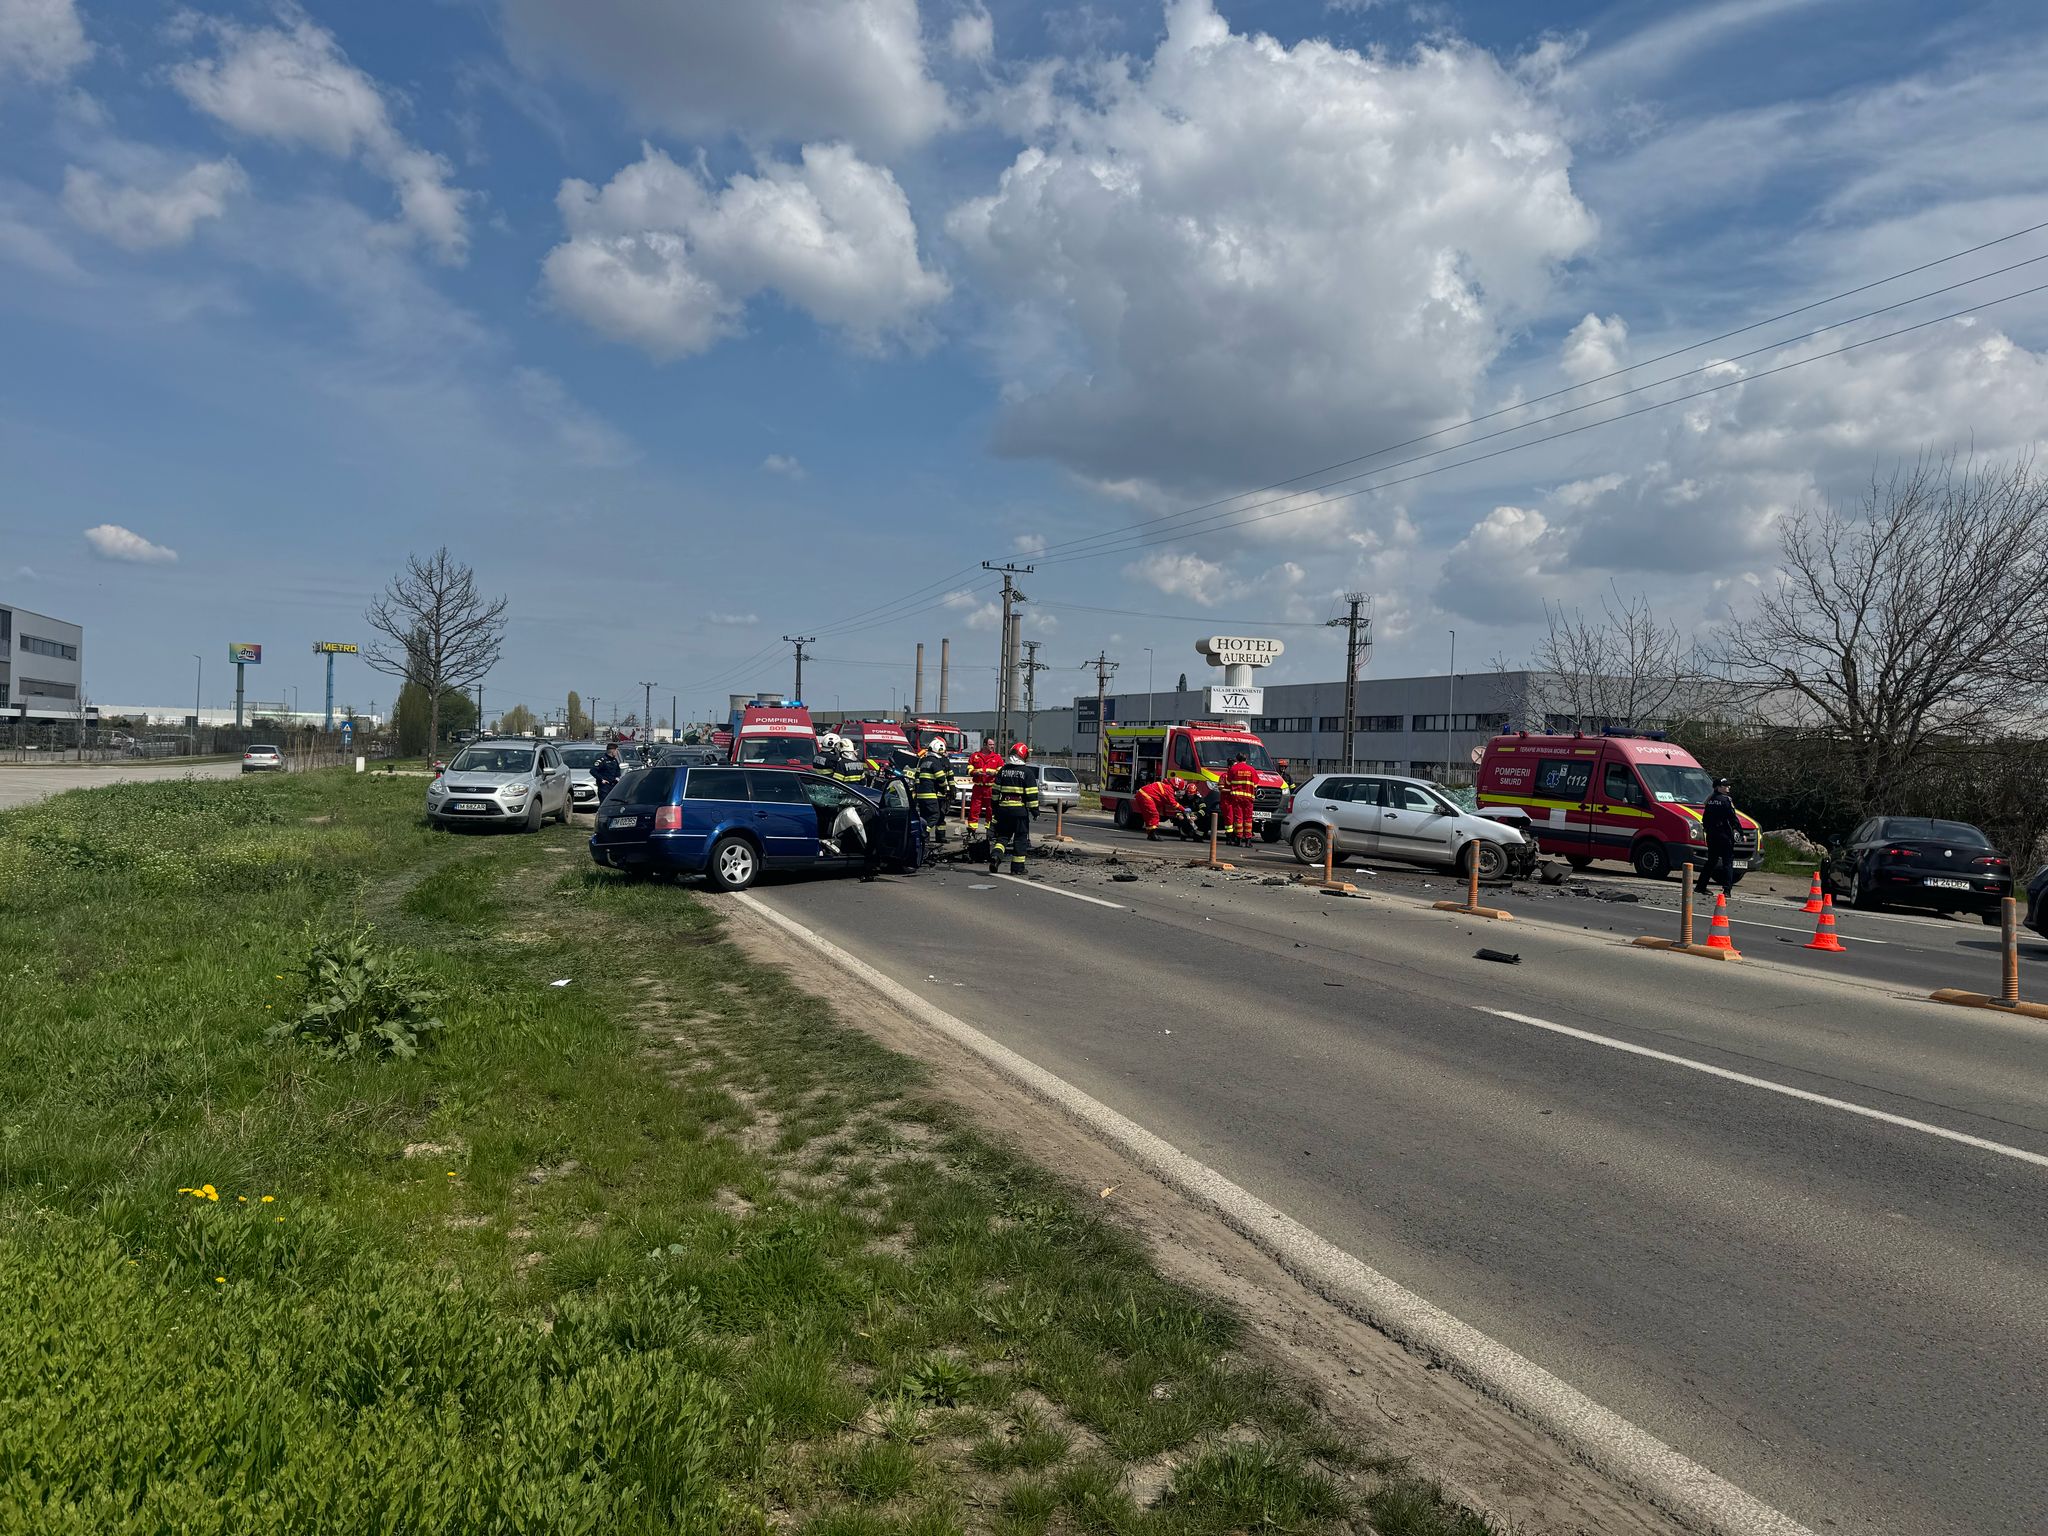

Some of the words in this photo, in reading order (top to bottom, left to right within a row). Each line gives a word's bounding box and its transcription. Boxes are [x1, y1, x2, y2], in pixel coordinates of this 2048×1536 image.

[322, 643, 357, 653] METRO
[1217, 638, 1278, 652] HOTEL
[1223, 653, 1271, 664] AURELIA
[1222, 695, 1250, 706] VIA
[1495, 767, 1531, 777] POMPIERII
[1500, 777, 1522, 786] SMURD
[1571, 776, 1588, 787] 112
